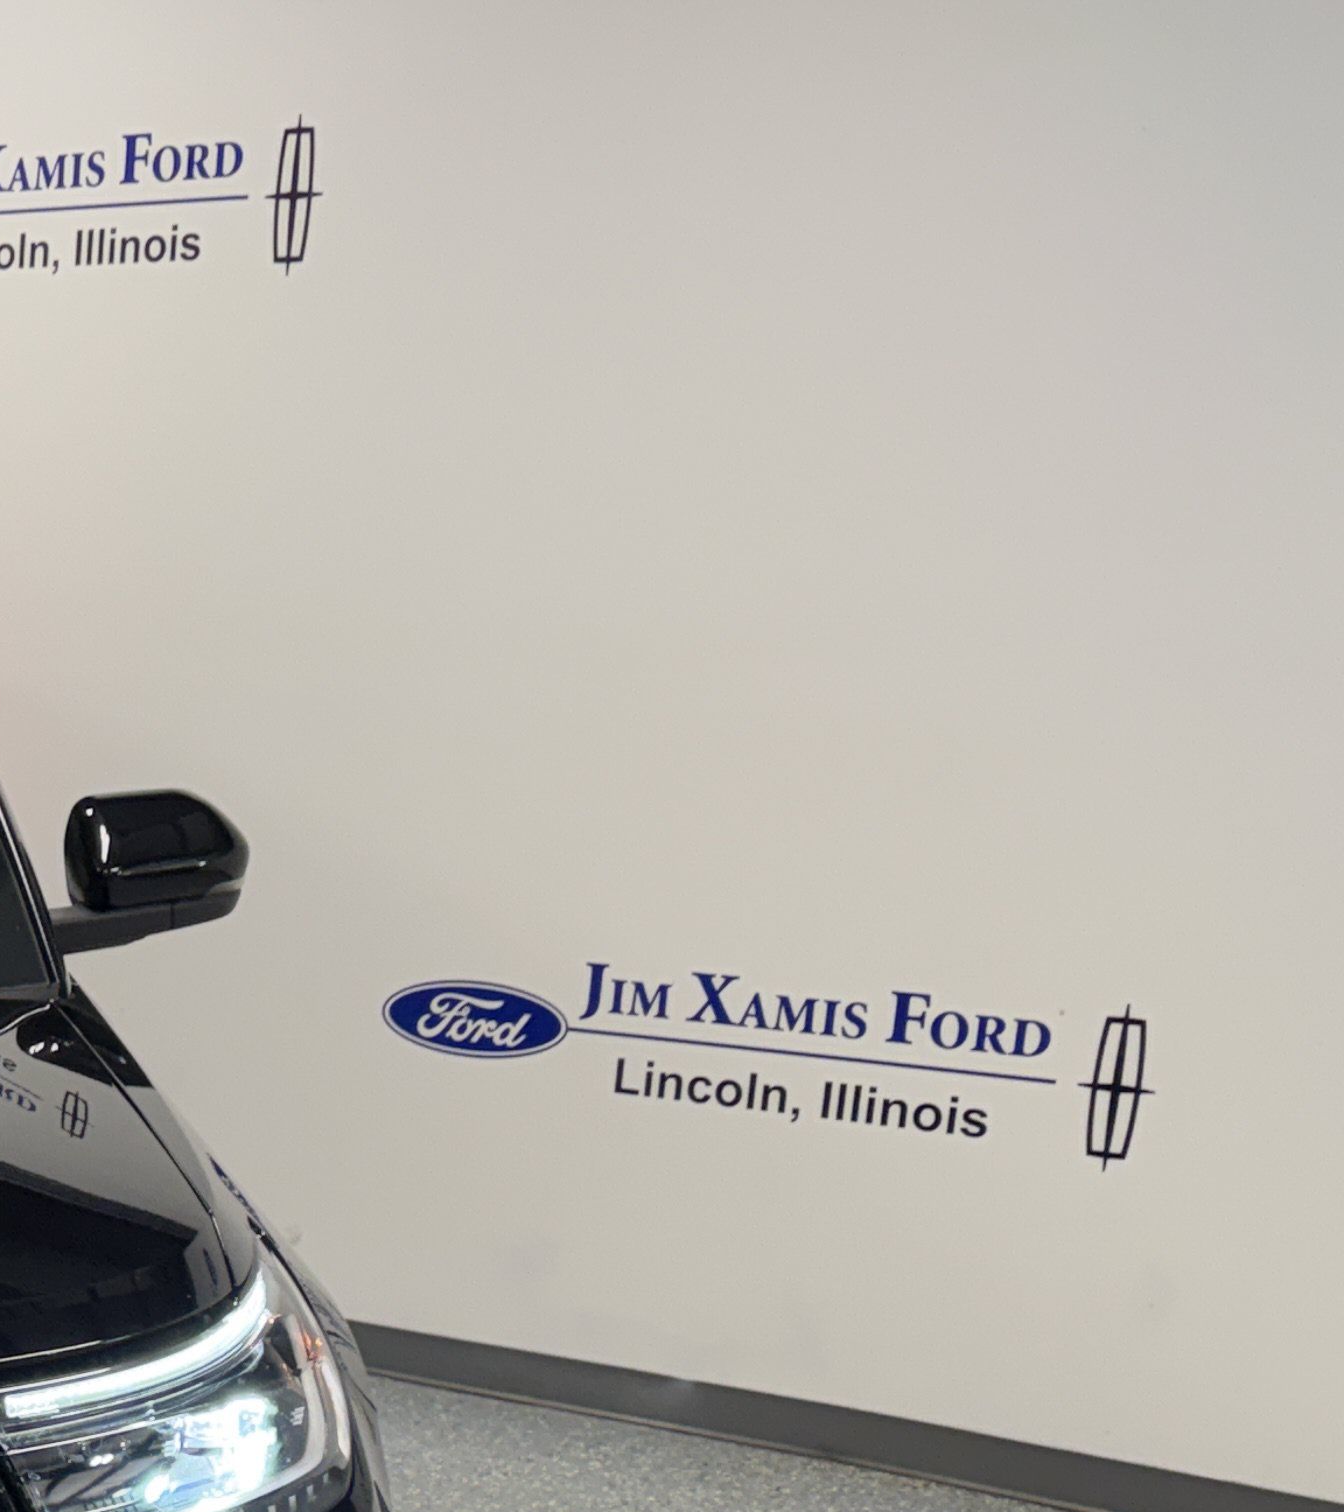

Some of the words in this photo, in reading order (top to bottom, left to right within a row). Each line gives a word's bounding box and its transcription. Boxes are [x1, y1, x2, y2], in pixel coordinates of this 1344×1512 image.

[120, 133, 243, 184] FORD
[76, 225, 200, 266] Illinois
[416, 991, 532, 1048] Ford
[580, 963, 671, 1020] JIM
[686, 973, 867, 1039] XAMIS
[886, 991, 1051, 1057] FORD
[615, 1058, 799, 1122] Lincoln,
[821, 1082, 987, 1137] Illinois
